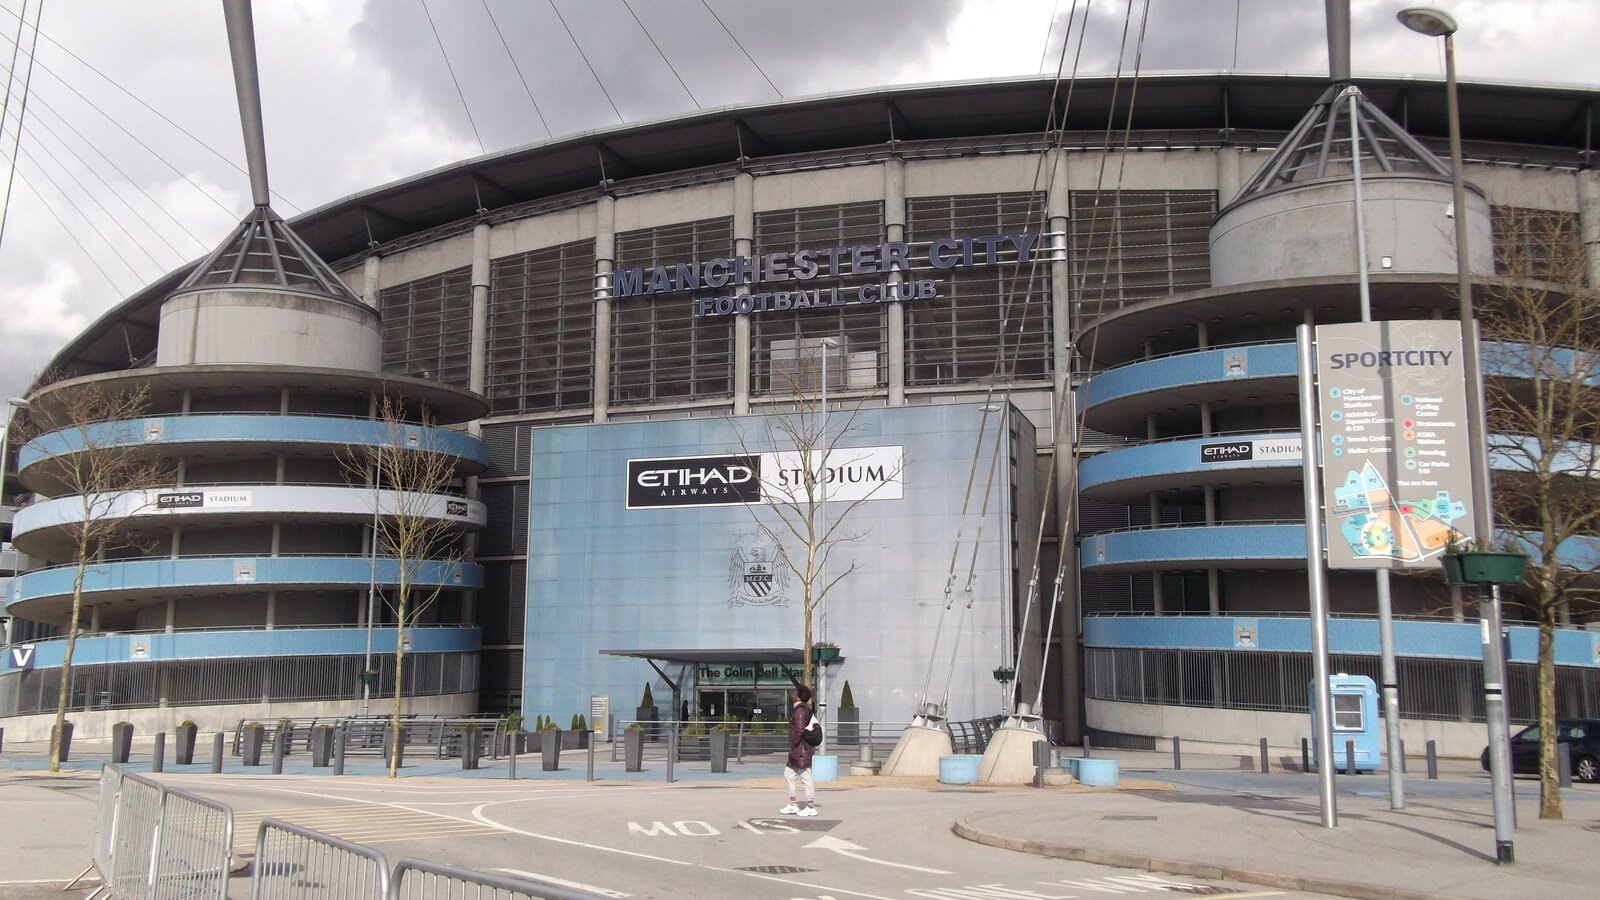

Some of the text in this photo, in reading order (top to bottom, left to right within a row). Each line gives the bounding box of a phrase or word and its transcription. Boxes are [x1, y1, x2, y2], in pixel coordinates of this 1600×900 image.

[613, 232, 1039, 298] MANCHESTER CITY
[700, 279, 937, 316] FOOTBALL CLUB
[1330, 351, 1453, 369] SPORTCITY
[1203, 445, 1250, 456] ETIHAD
[637, 466, 752, 487] ETIHAD
[160, 495, 201, 503] ETIHAD
[660, 487, 728, 496] AIRWAYS
[12, 649, 33, 667] V
[700, 667, 720, 678] The
[724, 667, 753, 678] Colin
[757, 667, 777, 678] Bell
